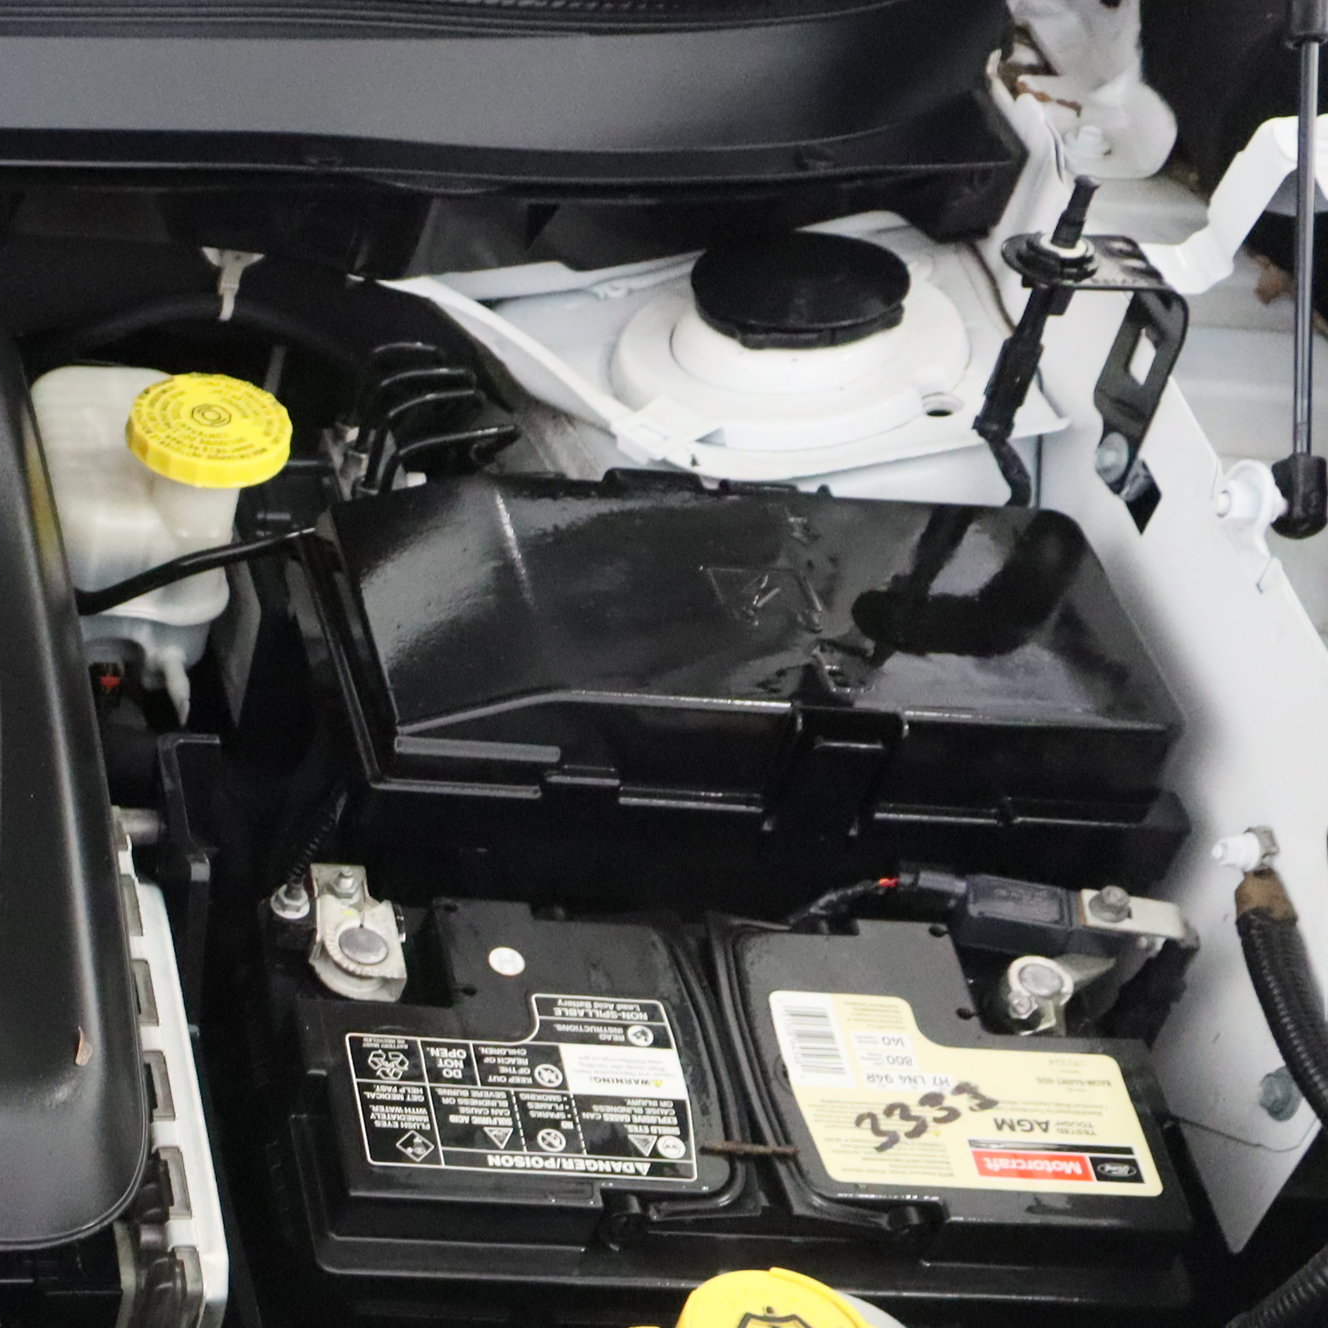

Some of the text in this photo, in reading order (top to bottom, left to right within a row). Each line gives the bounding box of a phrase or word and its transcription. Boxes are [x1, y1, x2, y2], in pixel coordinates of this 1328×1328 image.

[557, 999, 591, 1009] Battery
[553, 1007, 648, 1020] NON-SPILLABLE
[881, 1037, 905, 1047] 140
[426, 1047, 467, 1058] OPEN.
[436, 1058, 464, 1069] NOT
[885, 1055, 913, 1066] 800
[442, 1068, 462, 1078] DO
[487, 1075, 533, 1084] KEEP OUT
[866, 1072, 950, 1087] H7 LN4 94R
[399, 1086, 423, 1094] HELP
[406, 1094, 425, 1102] GET
[442, 1097, 456, 1105] OR
[519, 1093, 561, 1102] SMOKING
[527, 1101, 563, 1110] FLAMES
[402, 1106, 427, 1115] WITH
[490, 1107, 510, 1116] CAN
[529, 1110, 565, 1118] SPARKS
[582, 1112, 601, 1120] CAN
[400, 1121, 431, 1130] FLUSH
[993, 1117, 1049, 1134] AGM
[487, 1155, 635, 1174] DANGER/POISON
[982, 1157, 1083, 1175] Motorcraft
